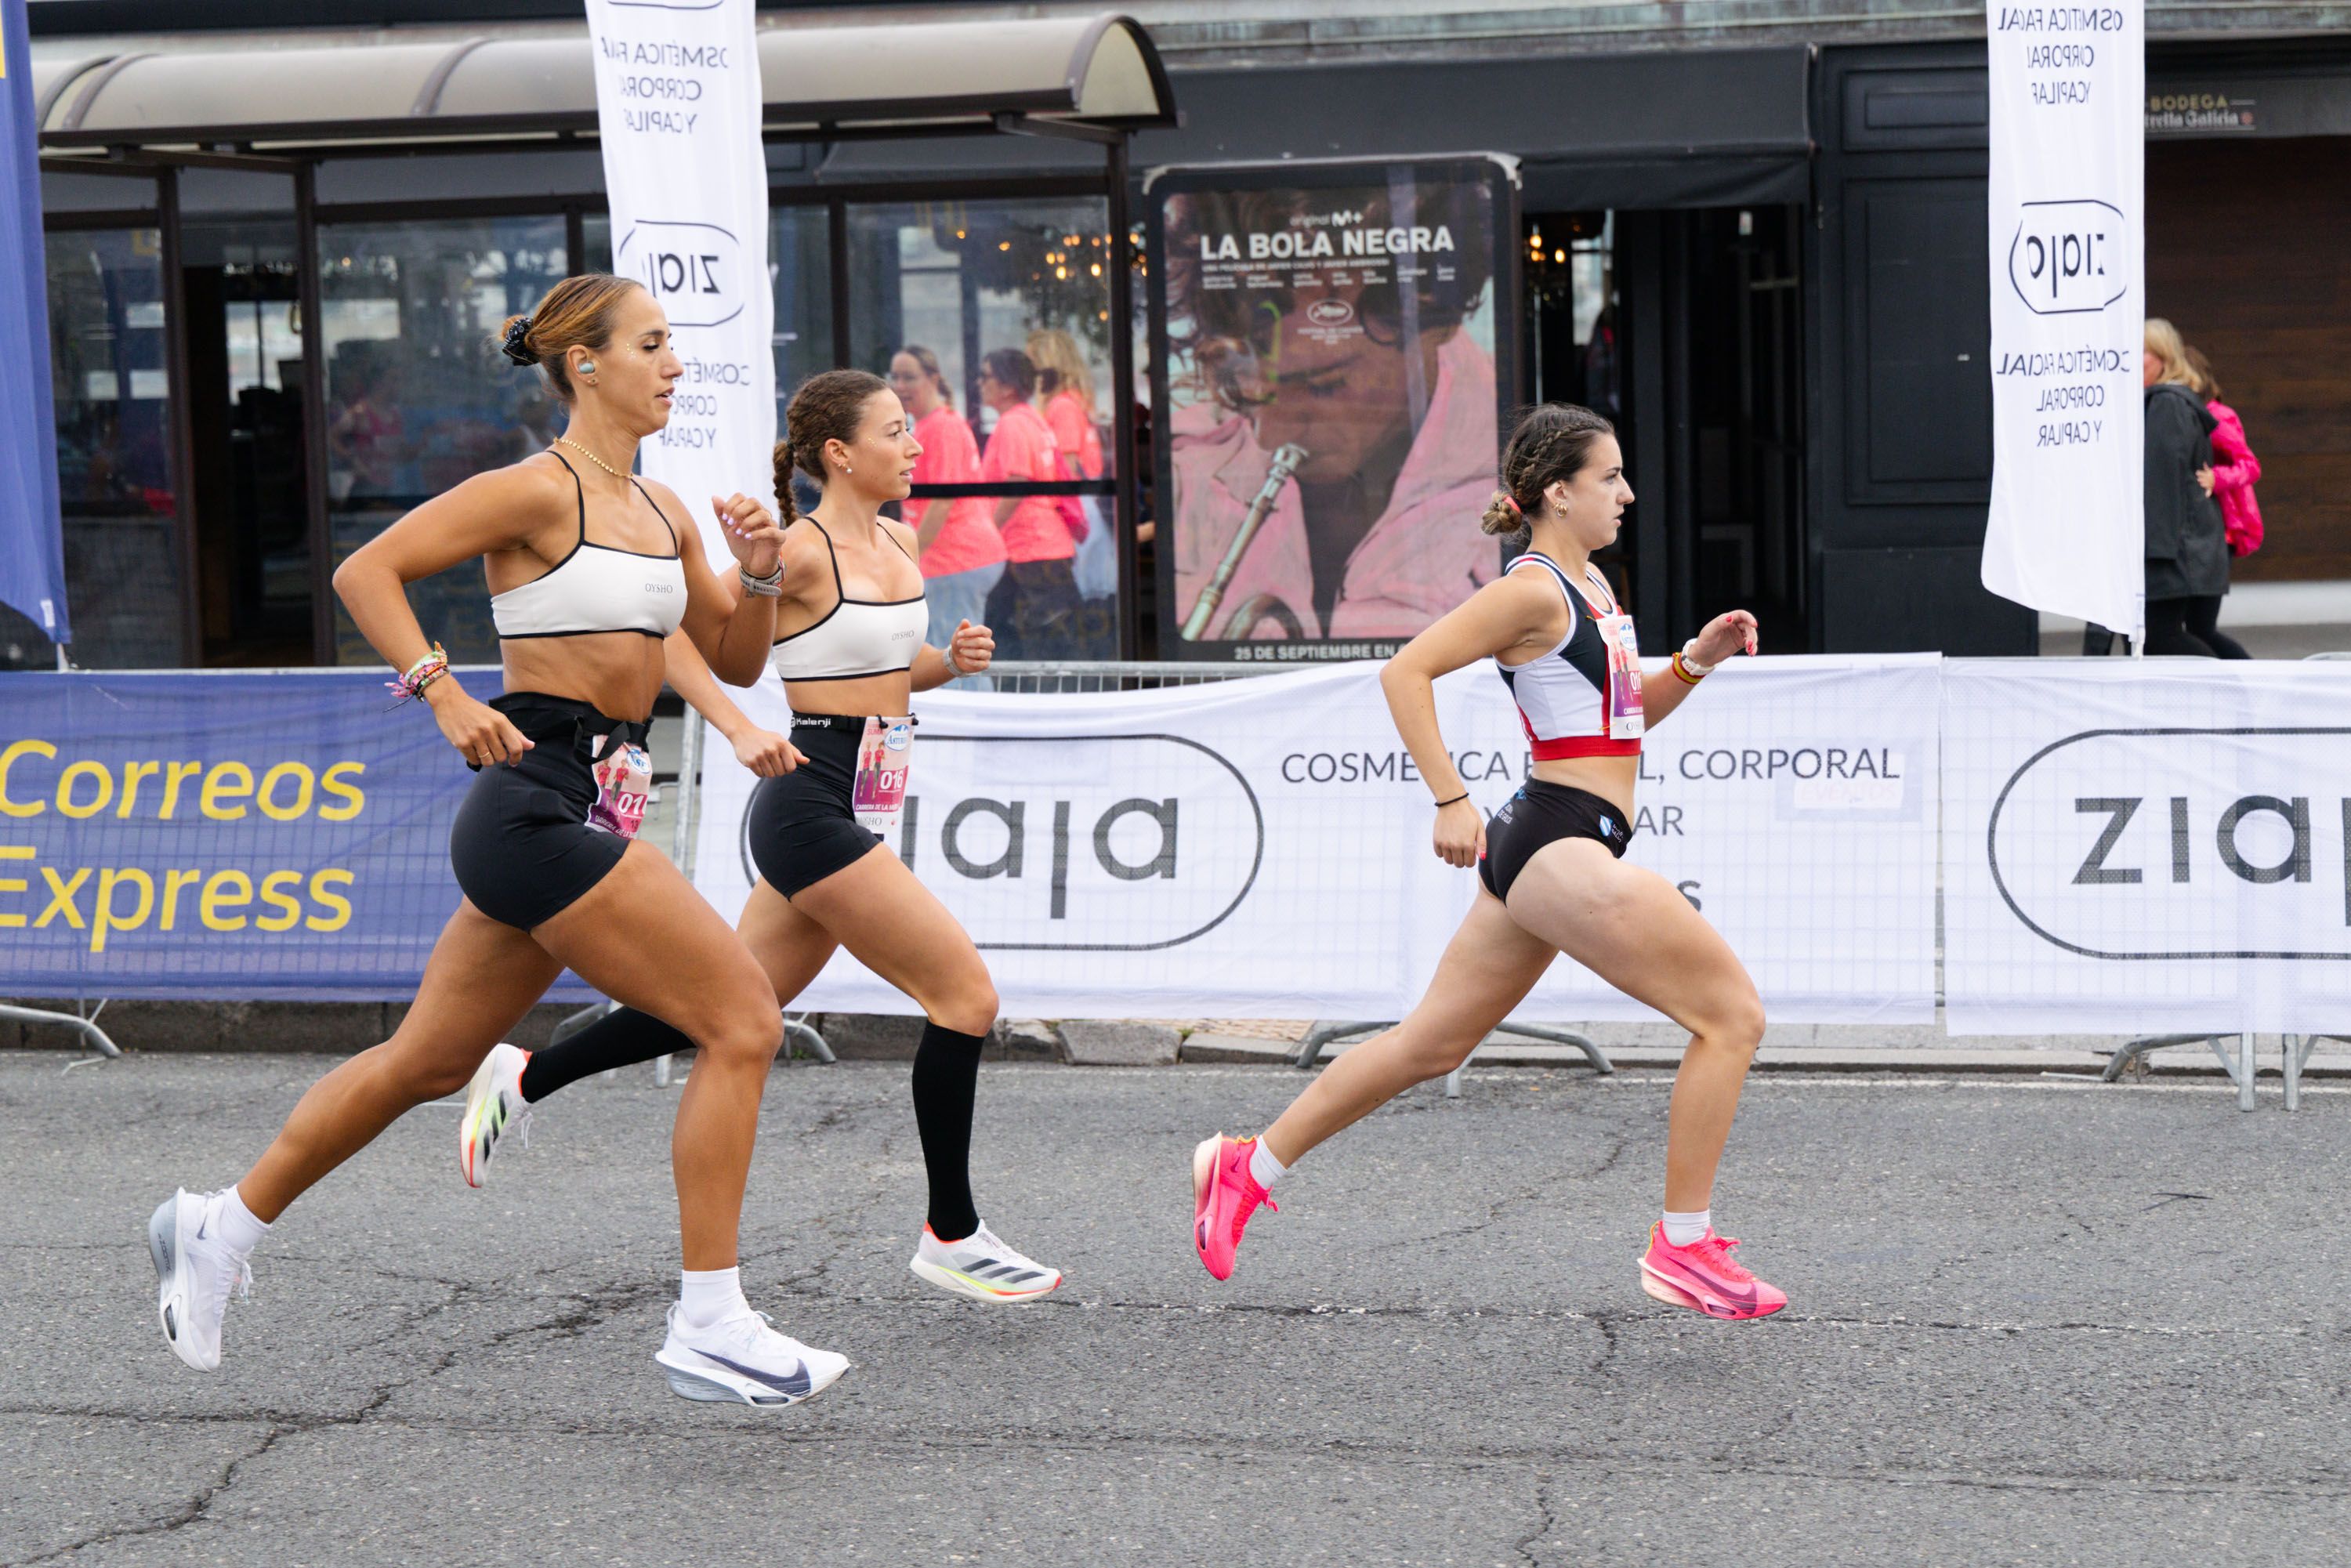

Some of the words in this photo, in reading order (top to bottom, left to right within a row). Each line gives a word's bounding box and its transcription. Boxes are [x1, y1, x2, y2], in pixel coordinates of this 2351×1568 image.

[2150, 94, 2228, 111] BODEGA
[2185, 109, 2239, 127] Galicia
[1201, 234, 1241, 260] LA
[1249, 230, 1334, 259] BOLA
[1342, 225, 1455, 255] NEGRA
[645, 583, 673, 594] OYSHO
[891, 629, 915, 641] OYSHO
[1234, 646, 1252, 660] 25
[1255, 646, 1275, 660] DE
[1277, 644, 1371, 660] SEPTIEMBRE
[1374, 643, 1395, 658] EN
[796, 717, 831, 728] Kalenji
[1679, 748, 1900, 780] CORPORAL
[0, 740, 366, 821] Correos
[880, 770, 904, 790] 016
[0, 846, 355, 953] Express
